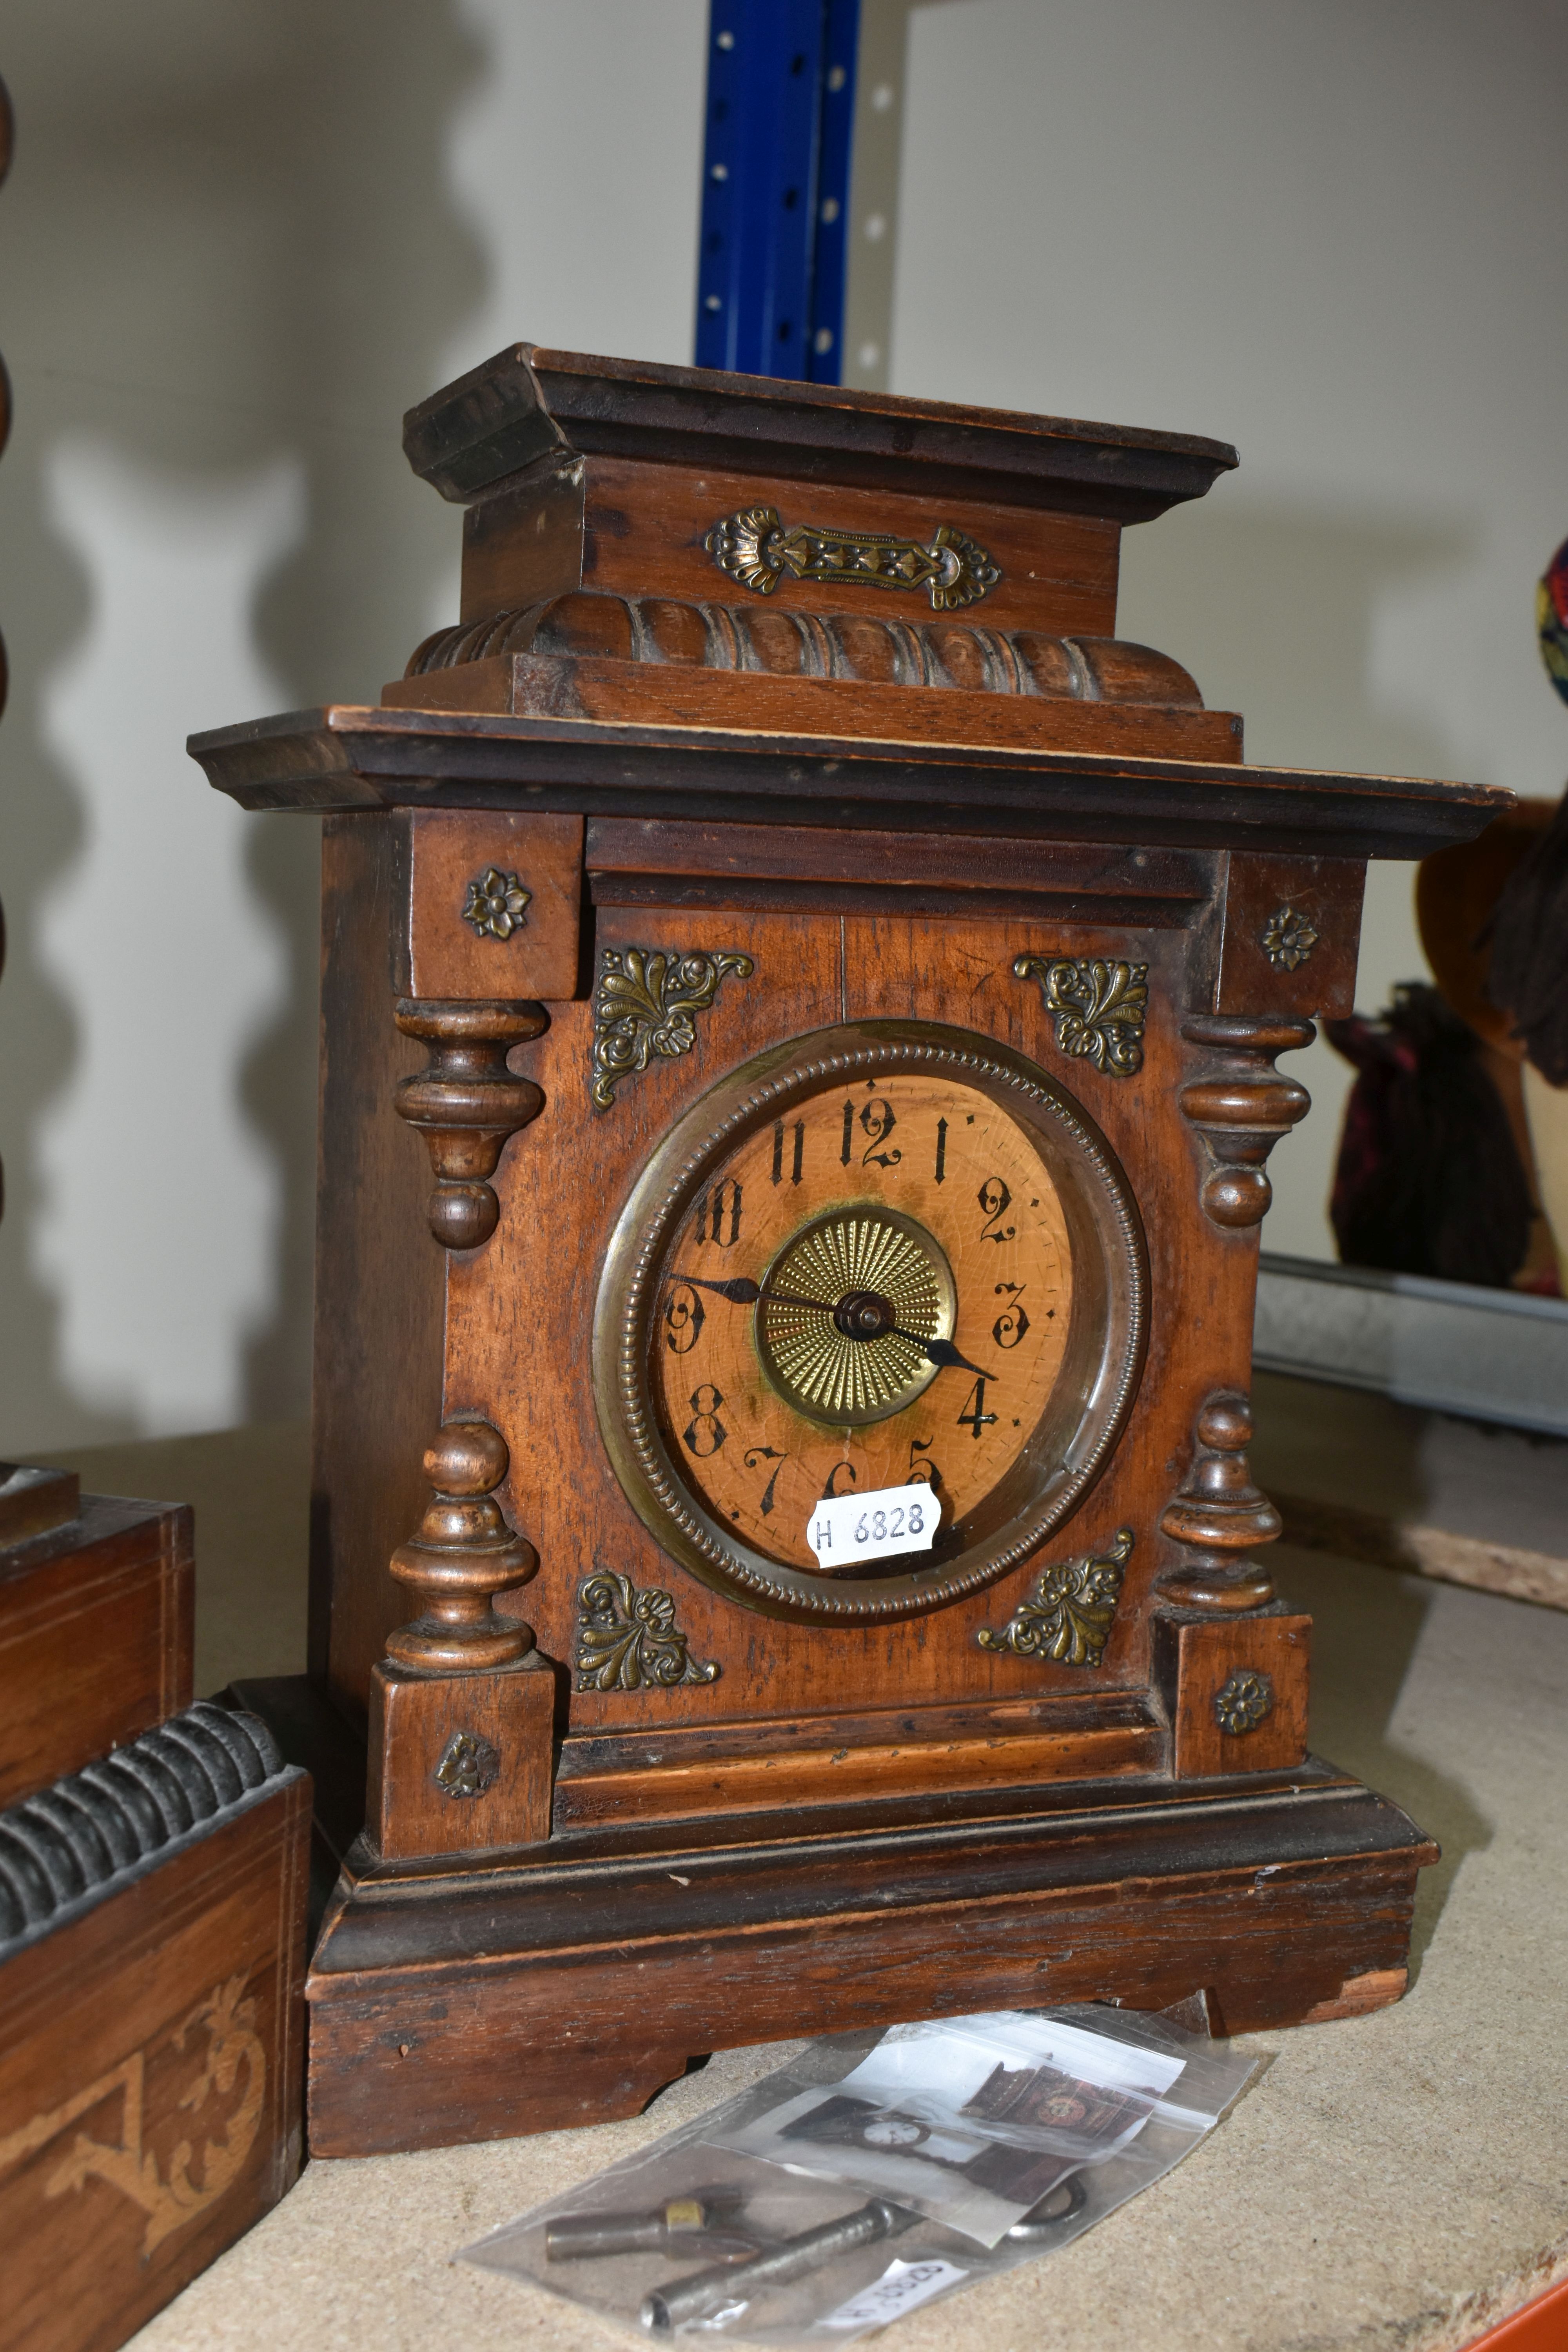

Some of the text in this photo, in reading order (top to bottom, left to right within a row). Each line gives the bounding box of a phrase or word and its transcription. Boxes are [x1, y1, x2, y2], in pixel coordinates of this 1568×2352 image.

[769, 1117, 806, 1187] 11
[839, 1098, 902, 1169] 12
[934, 1116, 949, 1186] 1
[694, 1178, 744, 1248] 10
[977, 1177, 1016, 1243] 2
[665, 1283, 706, 1354] 9
[992, 1283, 1031, 1348] 3
[682, 1384, 728, 1457] 8
[956, 1377, 999, 1439] 4
[744, 1446, 789, 1516] 7
[817, 1504, 924, 1550] H 6828
